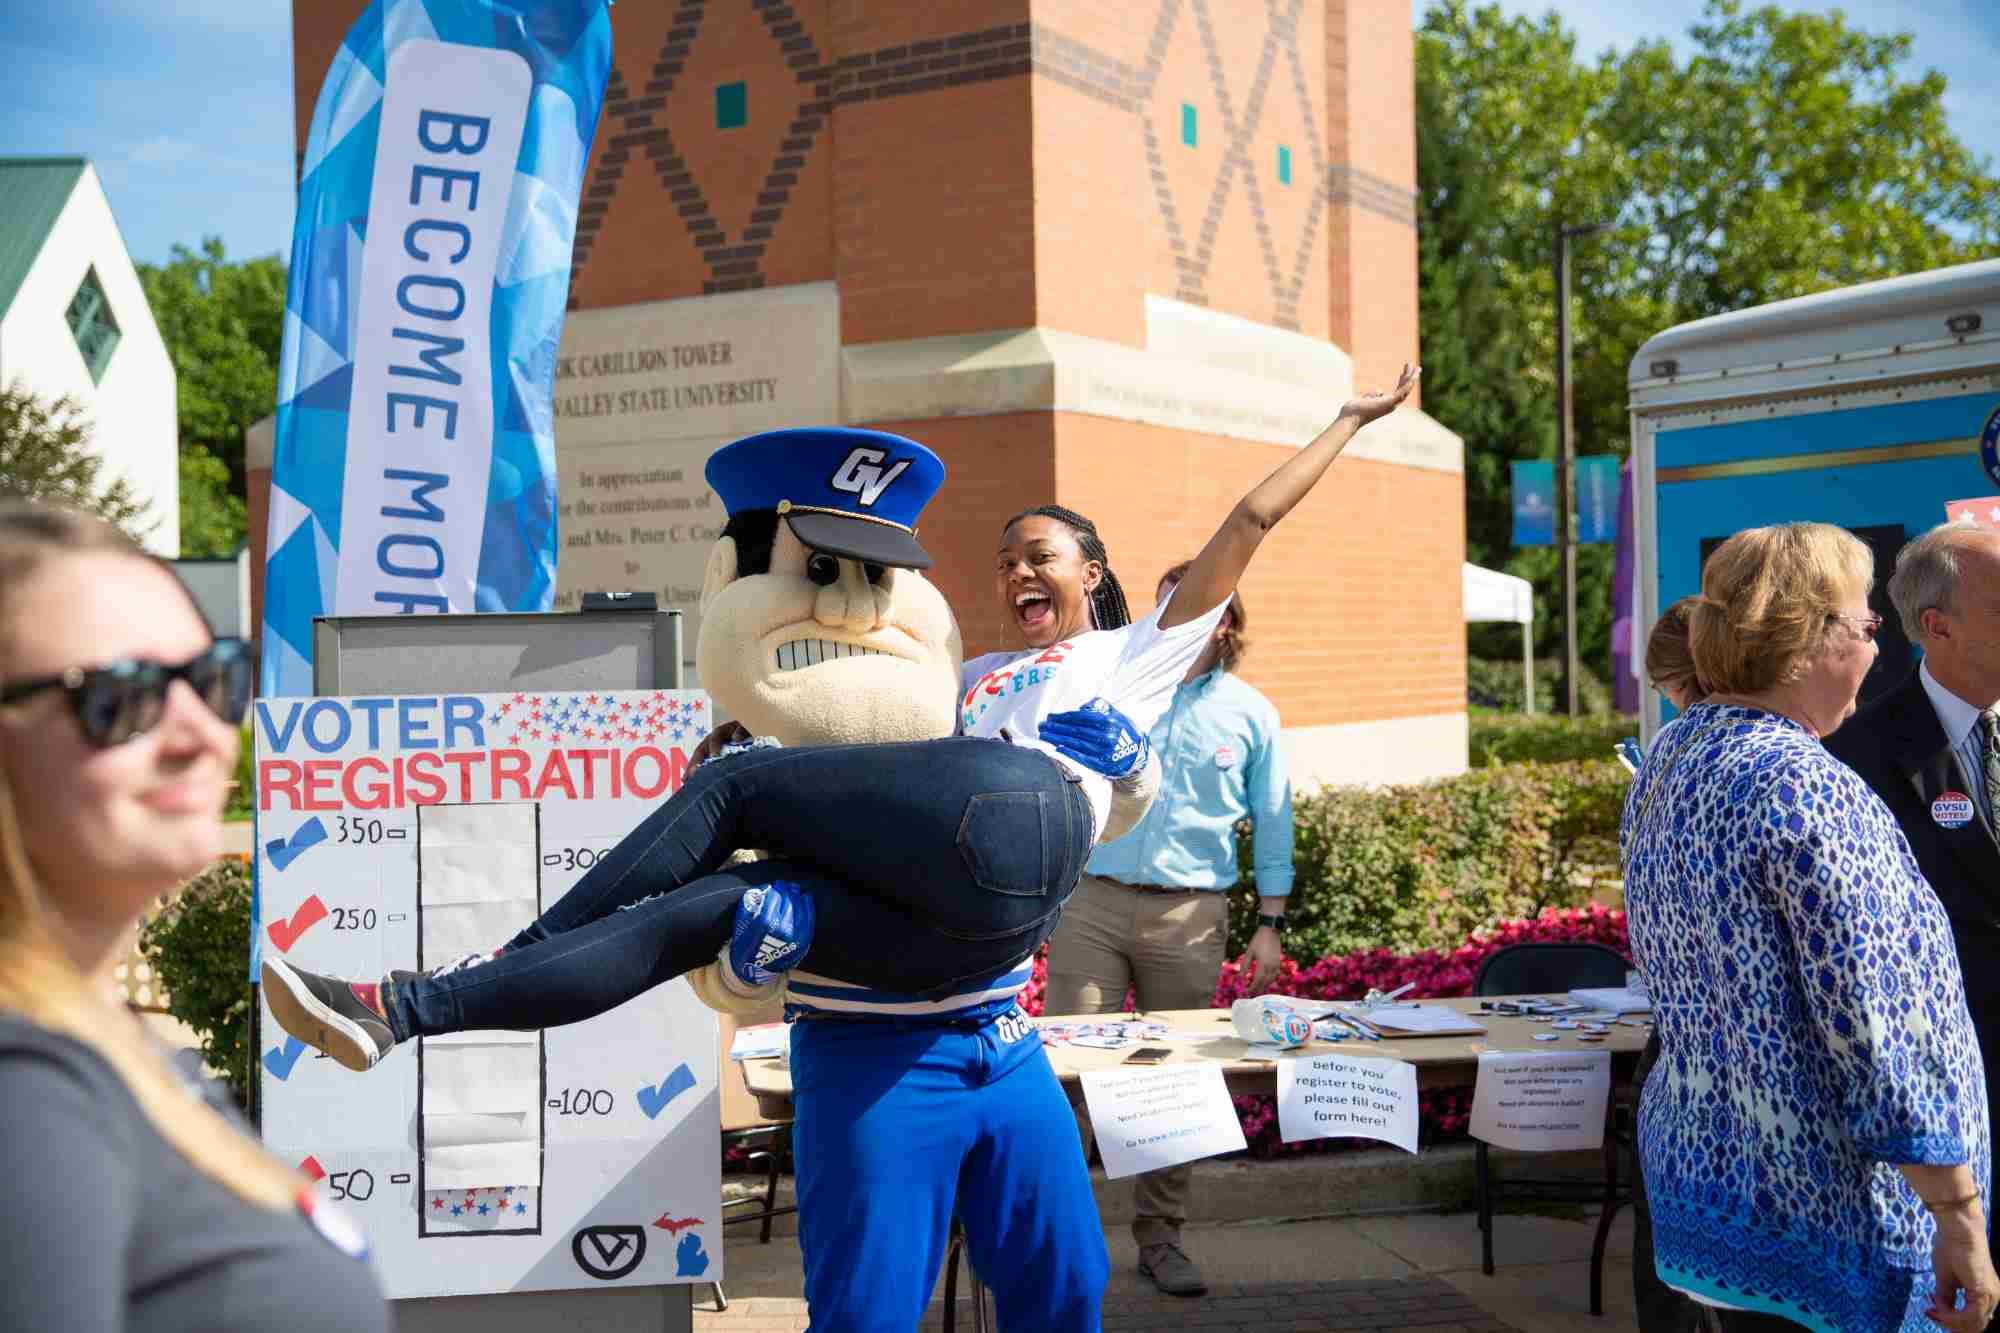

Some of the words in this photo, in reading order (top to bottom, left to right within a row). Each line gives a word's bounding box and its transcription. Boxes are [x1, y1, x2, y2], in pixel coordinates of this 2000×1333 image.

[387, 109, 490, 440] BECOME
[577, 349, 667, 378] CARILLION
[672, 341, 733, 369] TOWER
[555, 393, 613, 417] ALLEY
[618, 387, 670, 414] STATE
[674, 377, 778, 410] UNIVERSITY
[832, 448, 911, 506] GV
[568, 531, 592, 547] and
[256, 696, 486, 753] VOTER
[1935, 803, 1968, 812] GVSU
[335, 815, 382, 844] 350
[331, 907, 376, 931] 250
[755, 942, 797, 968] adidas
[1296, 1077, 1347, 1088] register
[1351, 1081, 1366, 1091] to
[1360, 1069, 1384, 1080] you
[559, 1088, 614, 1116] 100
[1304, 1094, 1348, 1105] please
[1352, 1095, 1369, 1107] fill
[1372, 1101, 1395, 1113] out
[1314, 1110, 1347, 1122] form
[1351, 1112, 1387, 1127] here!
[329, 1168, 375, 1201] 50
